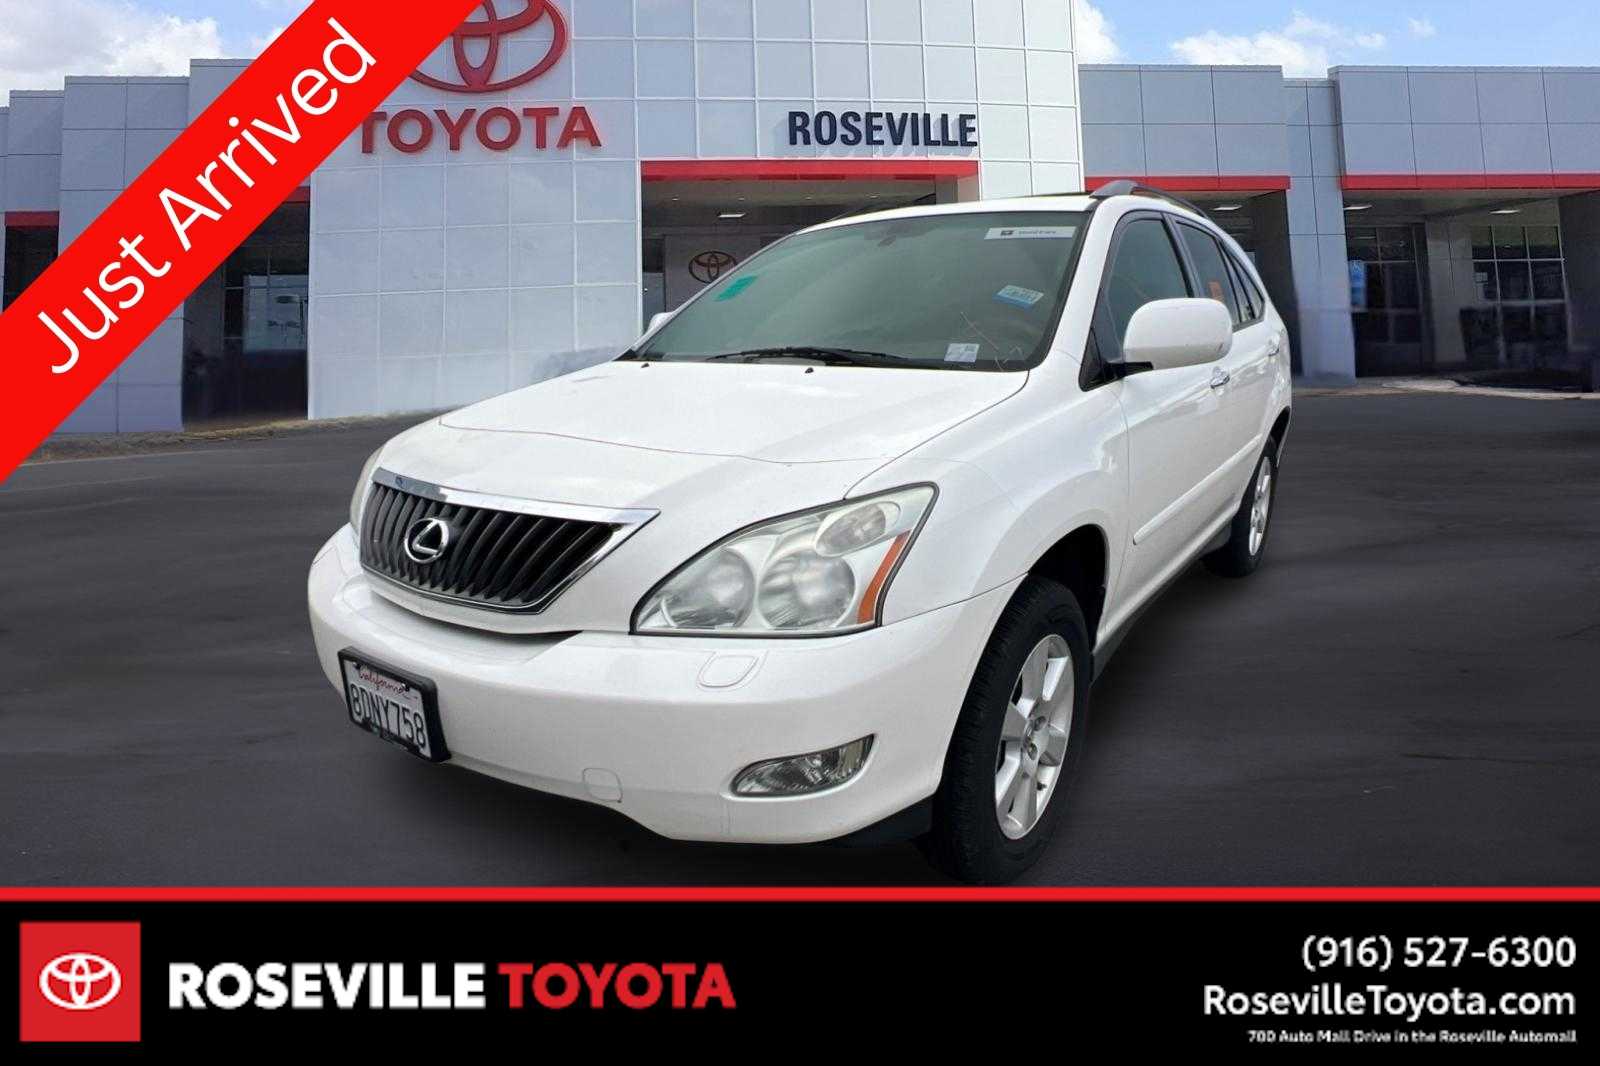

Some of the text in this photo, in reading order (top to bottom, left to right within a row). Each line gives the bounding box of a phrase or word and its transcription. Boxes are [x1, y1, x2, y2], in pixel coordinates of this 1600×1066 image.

[361, 105, 602, 154] TOYOTA
[788, 110, 978, 147] ROSEVILLE
[349, 683, 426, 748] 8DNY758
